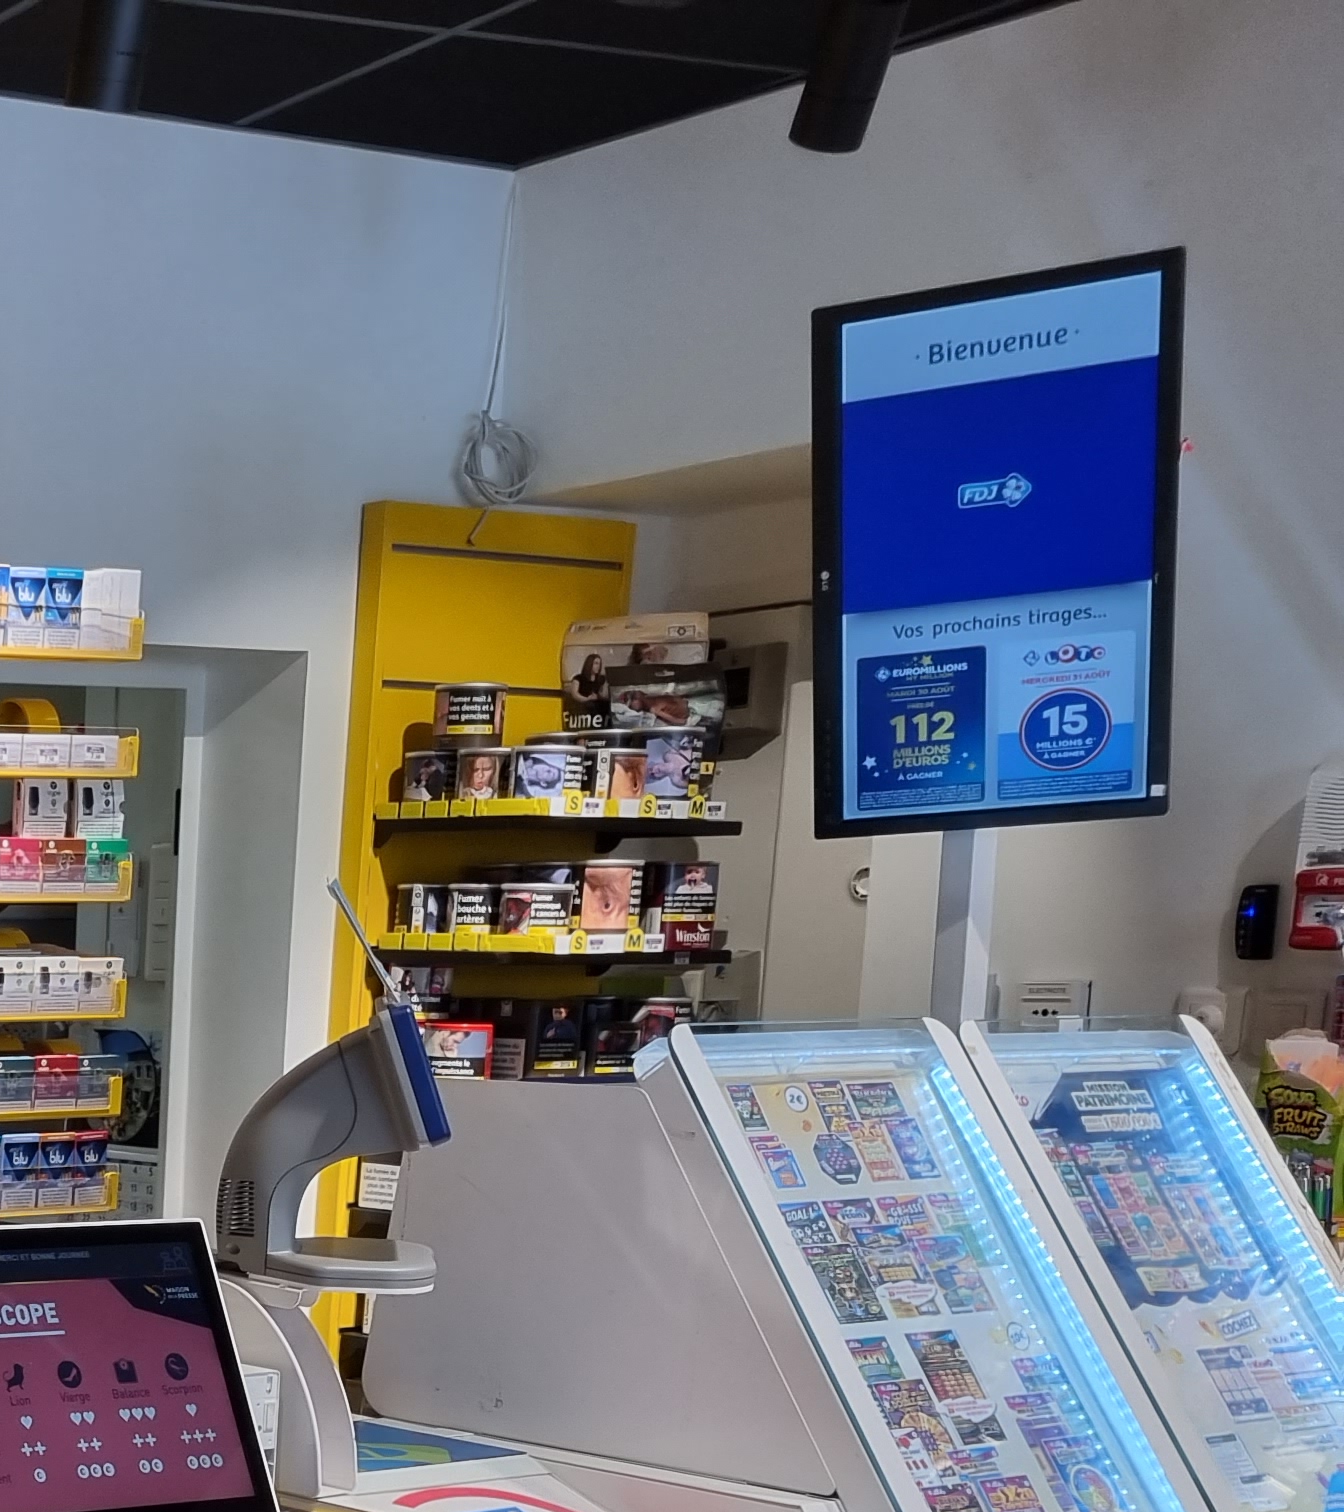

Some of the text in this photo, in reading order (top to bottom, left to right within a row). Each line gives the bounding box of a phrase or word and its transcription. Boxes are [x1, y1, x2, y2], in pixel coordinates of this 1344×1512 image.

[928, 327, 1069, 366] Bienvenue
[963, 484, 997, 503] FDJ
[18, 586, 35, 602] blu
[893, 606, 1107, 640] Vos prochains tirages...
[1044, 644, 1106, 665] LOTO
[892, 662, 968, 678] EUROMILLIONS
[461, 712, 490, 722] gencives
[1042, 704, 1089, 738] 15
[890, 711, 955, 744] 112
[893, 744, 951, 758] MILLIONS
[1036, 738, 1082, 749] MILLIONS
[893, 754, 950, 769] D'EUROS
[570, 793, 579, 810] S
[644, 801, 653, 815] S
[692, 802, 703, 815] M
[457, 894, 484, 905] Fumer
[457, 904, 486, 914] bouche
[456, 914, 485, 924] artères
[628, 935, 641, 947] M
[676, 926, 711, 943] Winston
[574, 936, 583, 950] S
[1086, 1083, 1128, 1093] MISSION
[1074, 1093, 1151, 1108] PATRIMOINE
[1273, 1107, 1326, 1125] FRUIT
[1273, 1122, 1321, 1138] STRAWS
[84, 1148, 99, 1163] blu
[1222, 1317, 1253, 1335] COCHEZ
[10, 1384, 204, 1407] Lion Vierge Balance Scorpion
